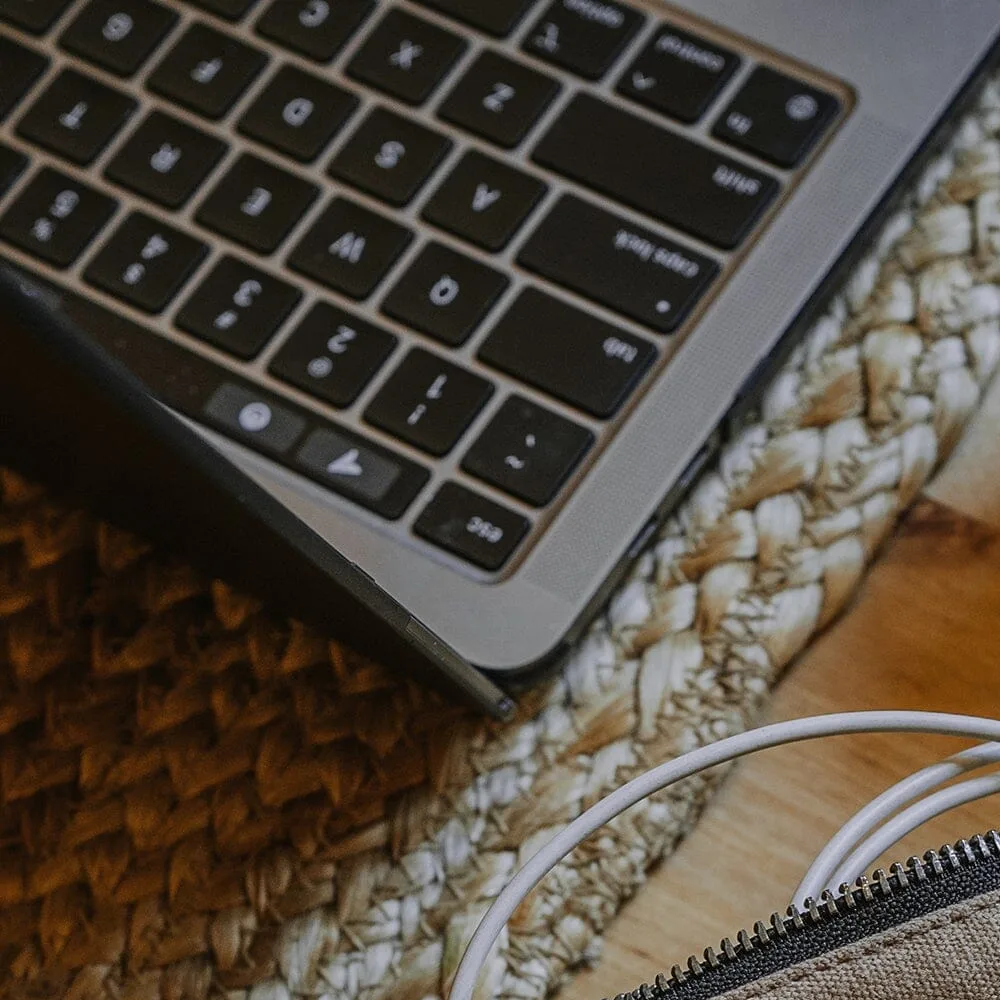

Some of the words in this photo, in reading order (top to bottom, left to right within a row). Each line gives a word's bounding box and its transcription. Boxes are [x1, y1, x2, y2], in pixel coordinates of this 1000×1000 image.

[299, 0, 329, 27] C
[390, 40, 423, 70] X
[191, 58, 223, 83] F
[483, 82, 515, 111] Z
[59, 101, 88, 129] T
[282, 97, 314, 127] D
[150, 143, 181, 173] R
[374, 140, 405, 169] S
[712, 164, 762, 196] shift
[241, 187, 272, 216] E
[472, 183, 501, 212] A
[328, 231, 366, 264] W
[614, 229, 652, 260] lock
[653, 248, 700, 278] caps
[233, 279, 262, 307] 3
[429, 274, 459, 305] Q
[327, 325, 357, 354] 2
[426, 374, 447, 399] 1
[466, 516, 503, 543] esc
